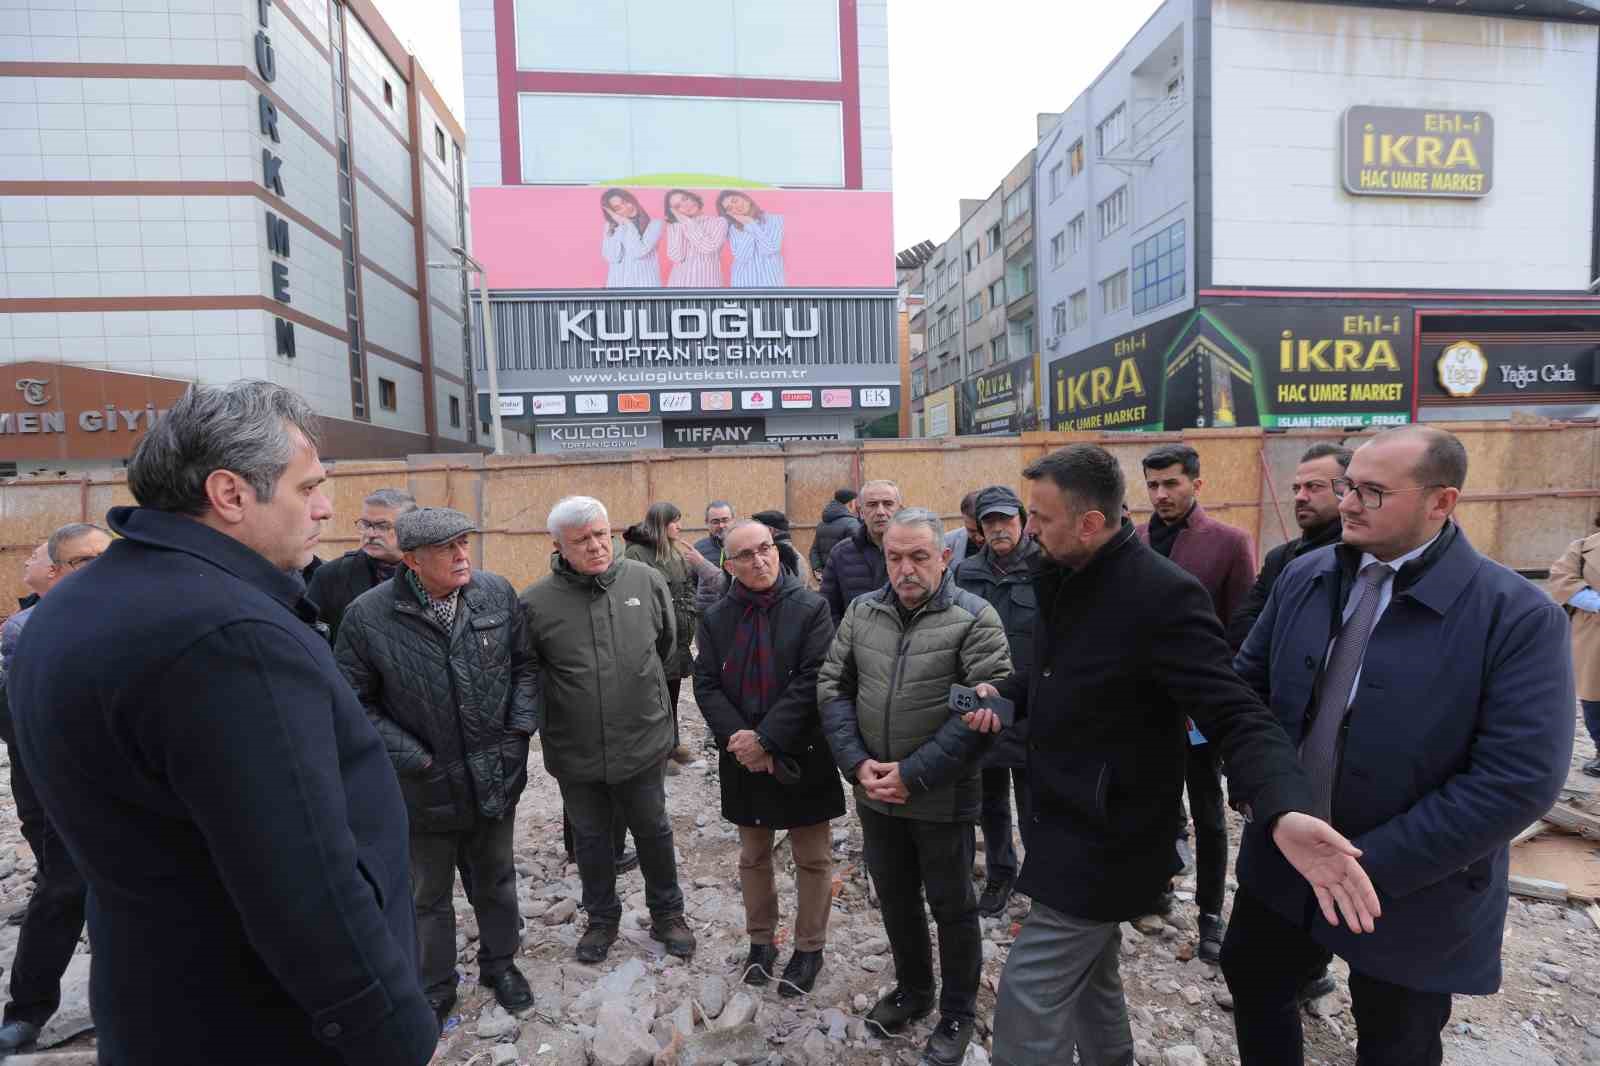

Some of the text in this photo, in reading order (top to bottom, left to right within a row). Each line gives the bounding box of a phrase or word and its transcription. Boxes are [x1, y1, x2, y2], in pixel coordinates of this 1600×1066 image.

[1362, 123, 1480, 169] İKRA
[1360, 169, 1485, 192] HAC UMRE MARKET
[559, 301, 819, 341] KULOĞLU
[1343, 315, 1401, 335] Ehl-i
[590, 340, 793, 362] TOPTAN İÇ GİYİM
[1114, 332, 1147, 357] Ehl-i
[1279, 329, 1401, 372] İKRA
[568, 368, 808, 383] www.kuloglutekstil.com.tr
[1056, 356, 1145, 414] İKRA
[1499, 364, 1537, 388] Yağcı
[1278, 383, 1403, 402] HAC UMRE MARKET
[79, 401, 168, 433] GİYİ
[1077, 413, 1102, 431] UMRE
[1104, 405, 1148, 425] MARKET
[551, 425, 648, 440] KULOĞLU
[674, 426, 752, 441] TIFFANY
